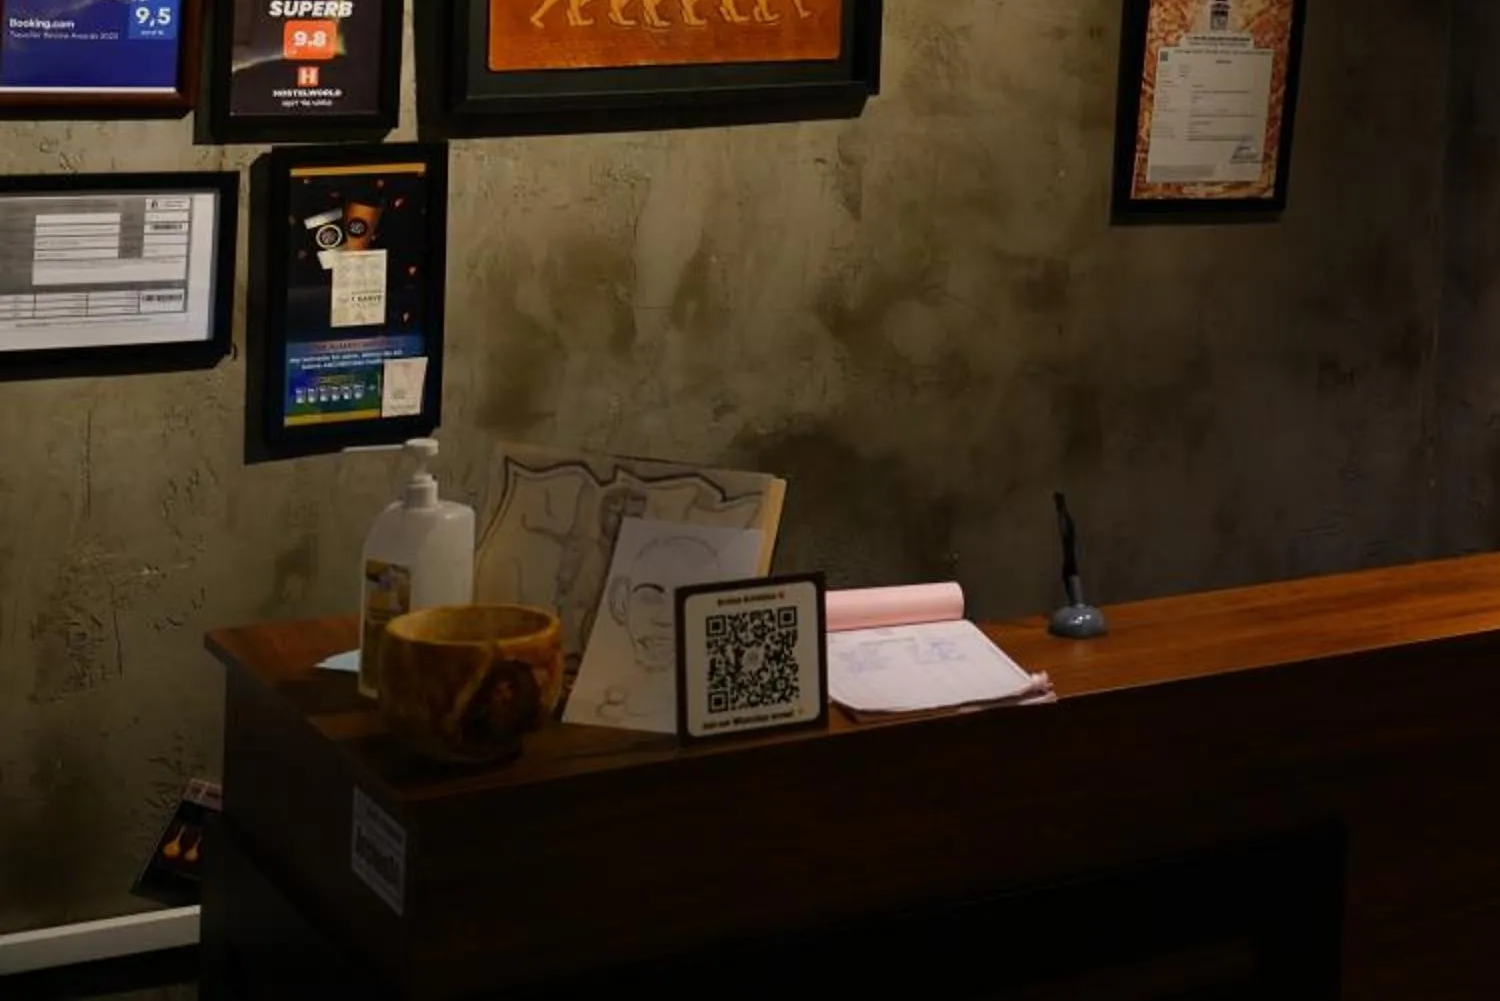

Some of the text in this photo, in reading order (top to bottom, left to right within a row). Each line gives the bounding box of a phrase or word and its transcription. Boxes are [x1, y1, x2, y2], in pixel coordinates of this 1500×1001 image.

[135, 6, 171, 27] 9,5
[268, 0, 353, 17] SUPERB
[9, 18, 75, 29] Booking.com
[293, 30, 327, 47] 9.8
